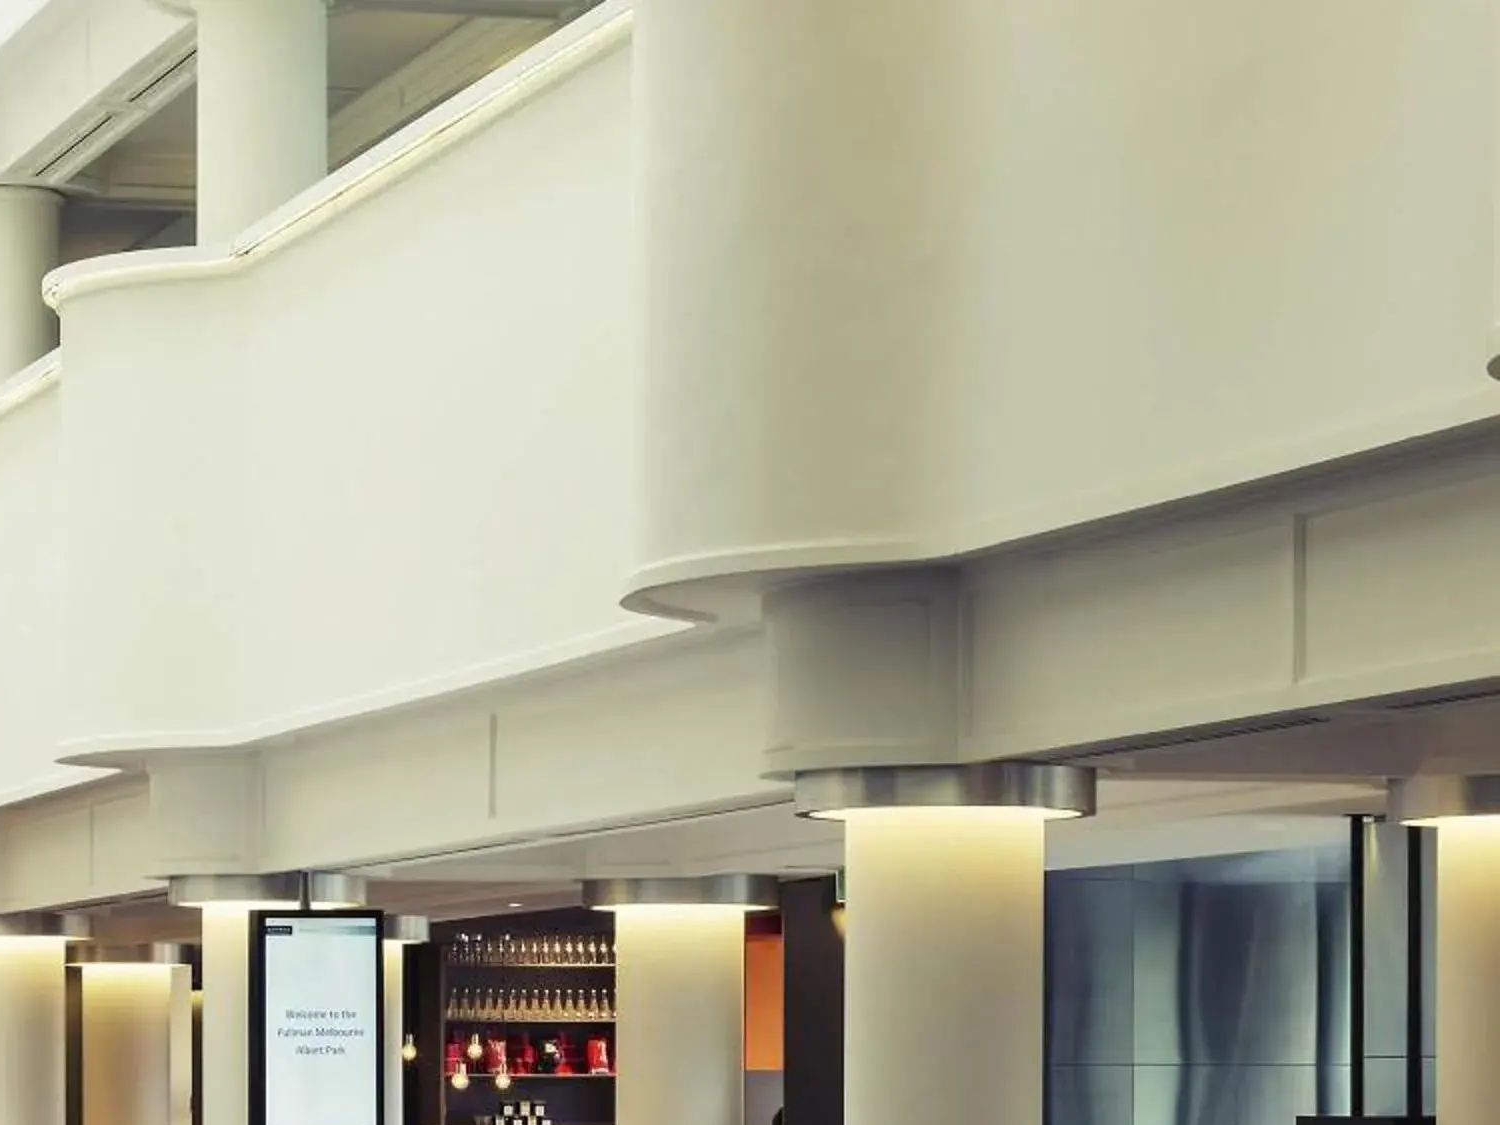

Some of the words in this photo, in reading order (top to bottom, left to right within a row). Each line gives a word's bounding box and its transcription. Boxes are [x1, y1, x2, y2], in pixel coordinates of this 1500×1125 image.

[285, 1010, 327, 1019] Welcome
[329, 1011, 339, 1019] to
[341, 1010, 356, 1019] the
[315, 1028, 364, 1037] Melbourne
[296, 1046, 324, 1055] Albert
[325, 1046, 345, 1055] Park
